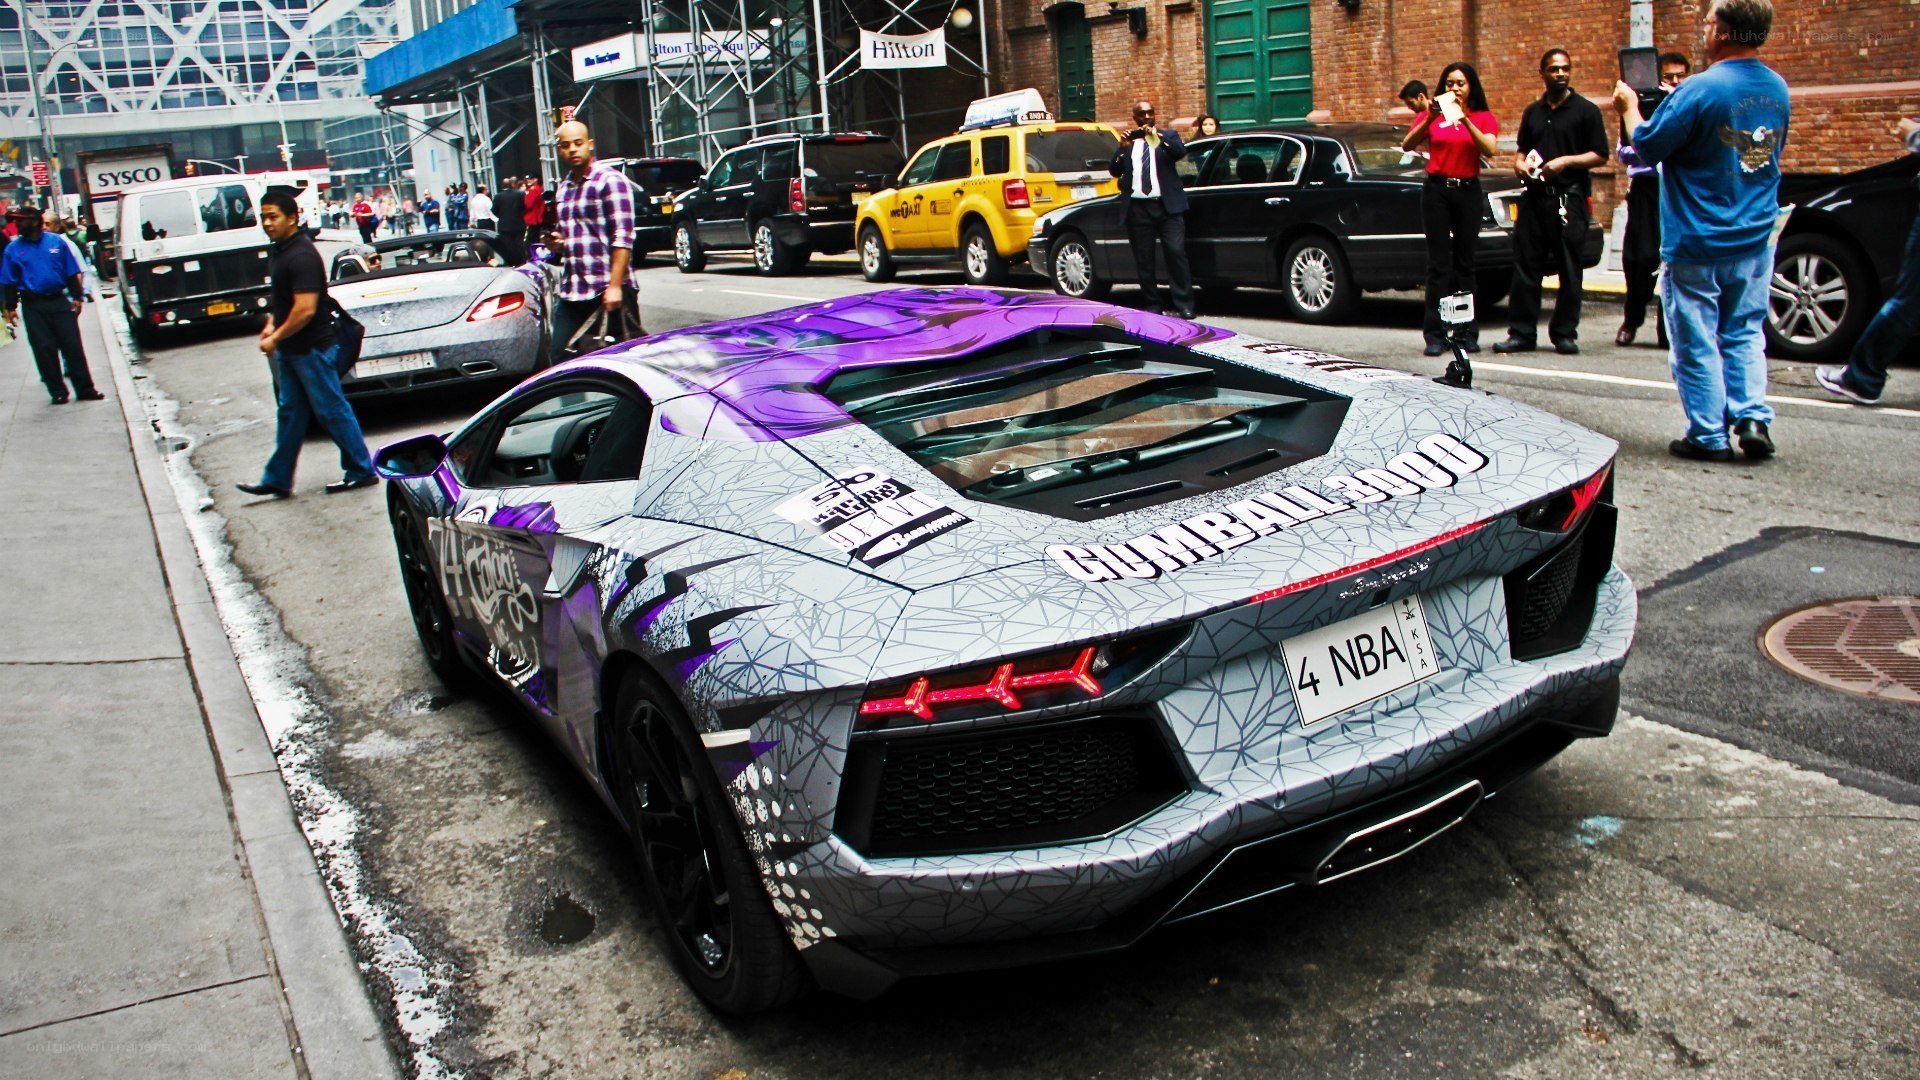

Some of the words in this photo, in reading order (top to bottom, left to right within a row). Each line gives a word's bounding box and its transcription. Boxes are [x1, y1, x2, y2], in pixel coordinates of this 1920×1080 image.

[651, 43, 682, 54] ilton
[871, 40, 935, 60] Hilton
[97, 167, 161, 187] SYSCO
[1044, 484, 1357, 583] GUMBALL
[1321, 433, 1490, 504] 3000
[1297, 655, 1321, 698] 4
[1328, 625, 1407, 687] NBA
